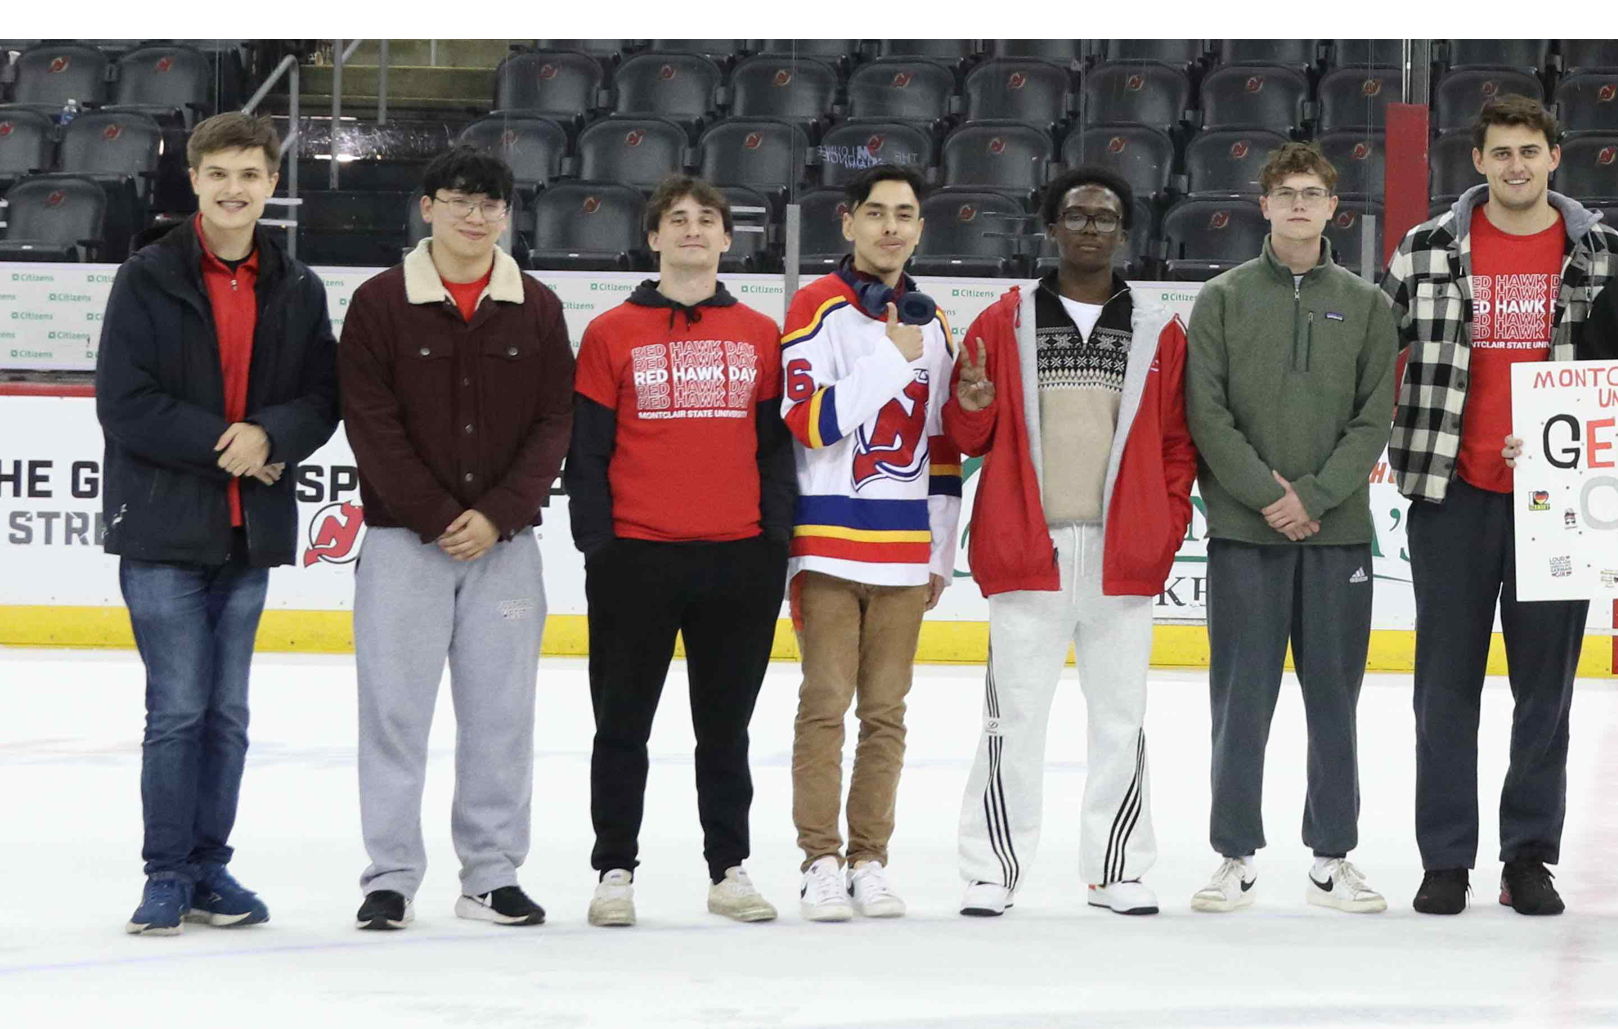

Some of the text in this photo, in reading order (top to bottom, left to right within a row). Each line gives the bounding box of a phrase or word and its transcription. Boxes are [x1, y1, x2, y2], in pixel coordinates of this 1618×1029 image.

[21, 274, 54, 282] Citizens
[1495, 273, 1547, 289] HAWK
[599, 283, 632, 292] Citizens
[750, 285, 783, 294] Citizens
[961, 289, 995, 298] Citizens
[1495, 287, 1546, 301] HAWK
[58, 293, 91, 302] Citizens
[1495, 299, 1546, 314] HAWK
[1495, 313, 1546, 327] HAWK
[1494, 325, 1544, 339] HAWK
[631, 344, 666, 360] RED
[669, 340, 721, 356] HAWK
[1506, 341, 1532, 349] STATE
[633, 352, 758, 371] RED HAWK DAY
[634, 367, 757, 385] RED HAWK DAY
[786, 359, 815, 402] 6
[637, 382, 670, 397] RED
[674, 380, 725, 395] HAWK
[638, 395, 670, 410] RED
[674, 393, 725, 408] HAWK
[638, 411, 686, 419] MONTCLAIR
[688, 410, 713, 418] STATE
